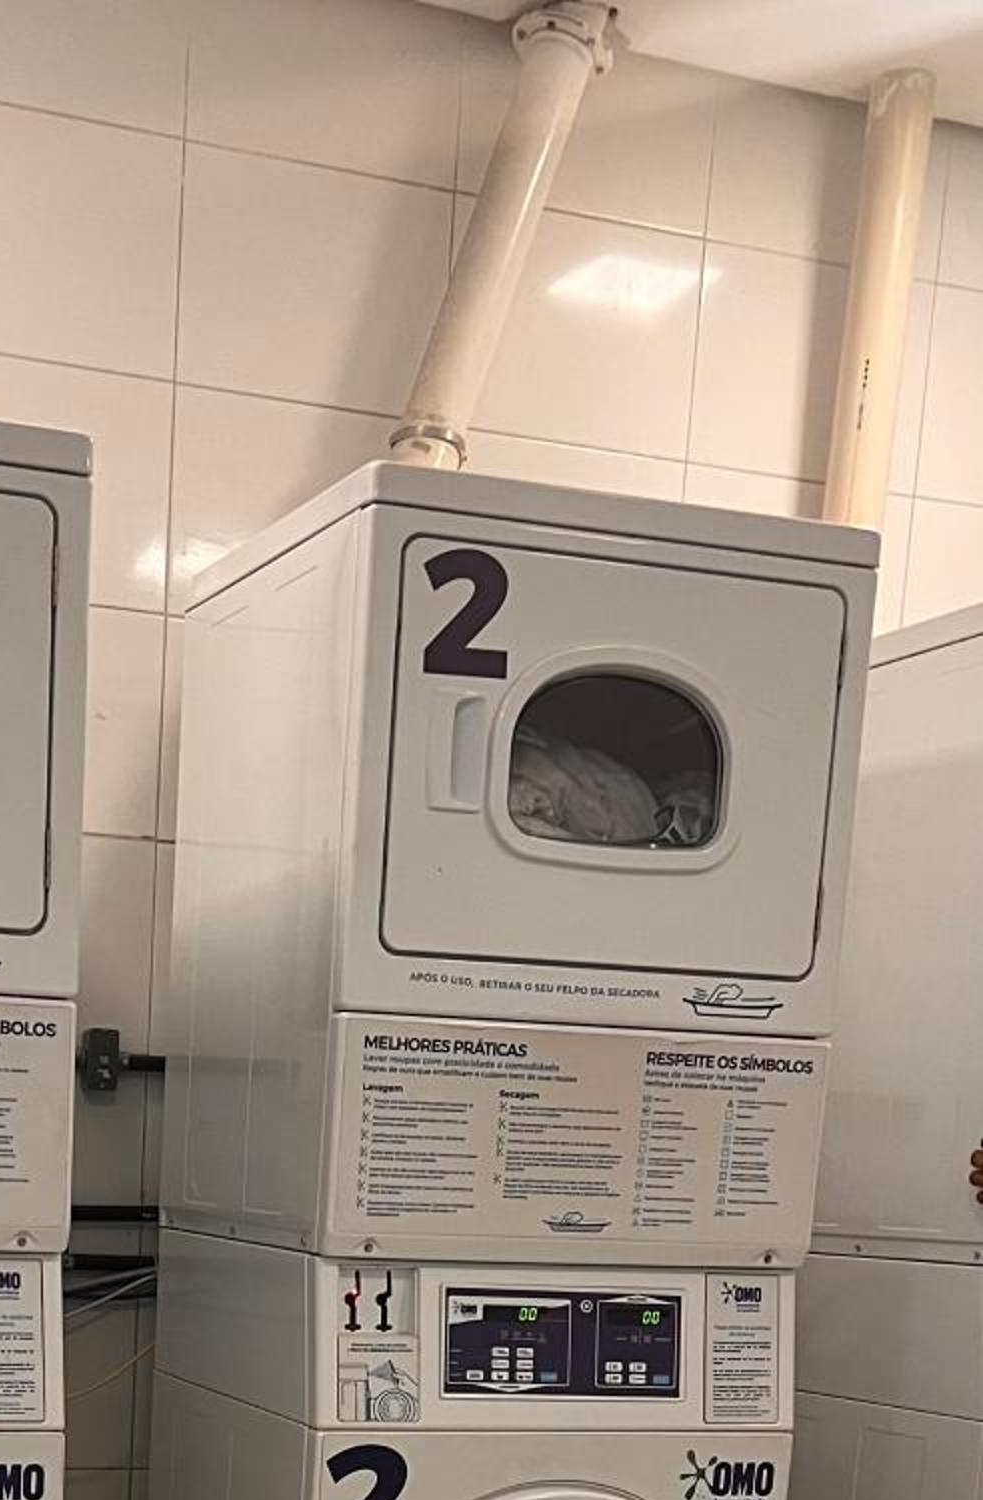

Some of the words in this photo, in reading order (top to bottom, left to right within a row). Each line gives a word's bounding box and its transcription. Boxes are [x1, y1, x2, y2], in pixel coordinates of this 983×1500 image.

[423, 548, 508, 679] 2
[441, 974, 448, 983] O
[479, 979, 521, 990] RETIRAR
[524, 983, 532, 992] O
[534, 983, 553, 993] SEU
[556, 984, 587, 995] FELPO
[590, 986, 605, 997] DA
[608, 987, 660, 999] SECADORA
[364, 1035, 451, 1054] MELHORES
[453, 1038, 528, 1058] PRÁTICAS
[646, 1051, 715, 1069] RESPEITE
[717, 1055, 737, 1070] OS
[739, 1053, 813, 1074] SÍMBOLOS
[363, 1082, 404, 1094] Lavagem
[499, 1088, 539, 1101] Secagem
[734, 1287, 762, 1302] OMO
[519, 1307, 538, 1321] 00
[642, 1310, 660, 1325] 00
[711, 1461, 774, 1497] OMO
